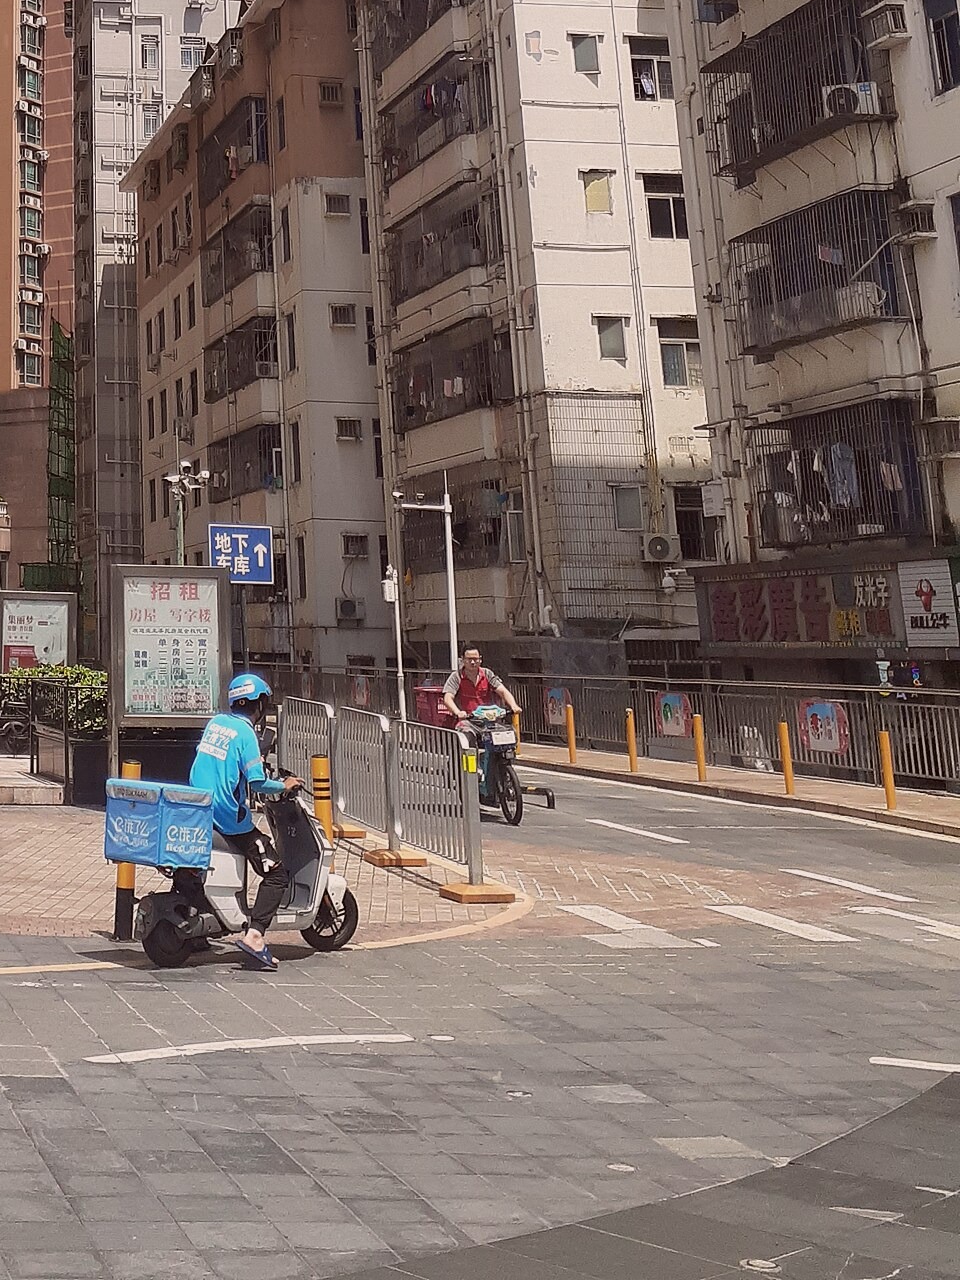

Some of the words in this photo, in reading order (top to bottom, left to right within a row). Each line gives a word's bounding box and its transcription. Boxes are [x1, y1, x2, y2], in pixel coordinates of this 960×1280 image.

[214, 532, 249, 554] 地下
[216, 553, 250, 575] 车库
[151, 581, 200, 601] 招租
[854, 574, 889, 607] 发光字
[129, 607, 157, 623] 房屋
[169, 607, 211, 623] 写字楼
[158, 638, 207, 647] 单身公寓
[158, 648, 207, 657] 一房一厅
[158, 657, 207, 666] 二房二厅
